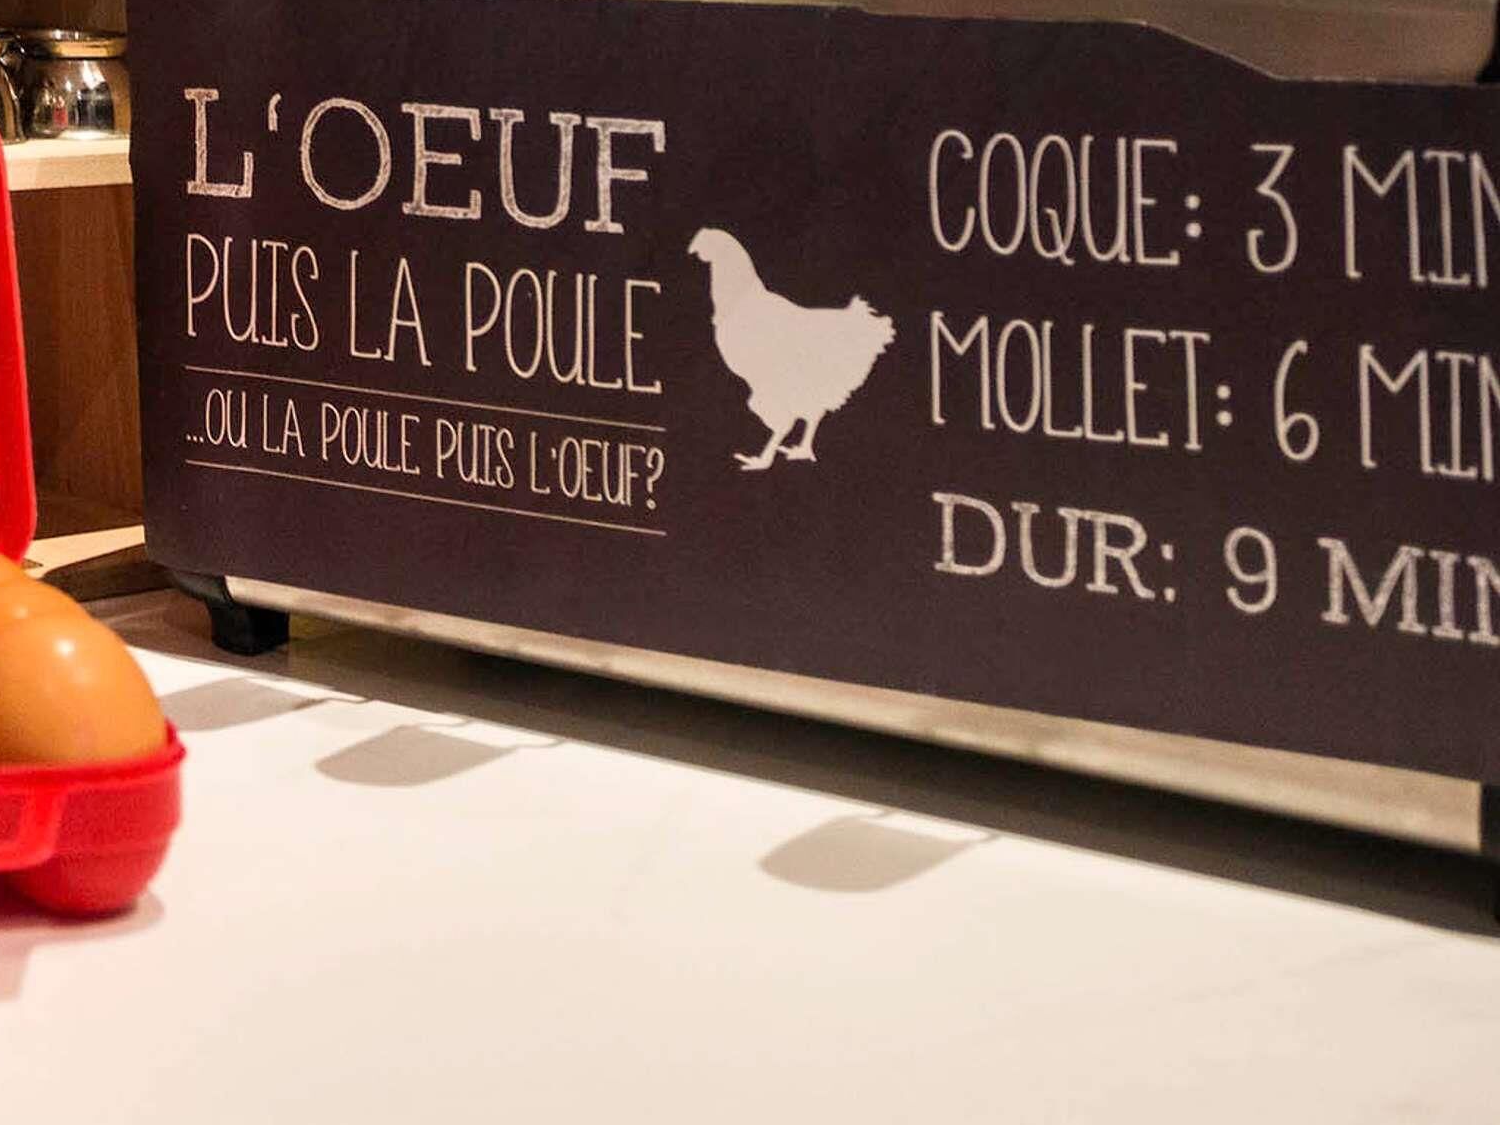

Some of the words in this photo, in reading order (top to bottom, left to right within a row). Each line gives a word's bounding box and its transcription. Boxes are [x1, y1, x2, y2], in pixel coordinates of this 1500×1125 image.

[184, 88, 665, 235] L'OEUF
[929, 129, 1201, 266] COQUE:
[1247, 143, 1297, 273] 3
[187, 234, 318, 350] PUIS
[350, 250, 431, 366] LA
[463, 262, 662, 393] POULE
[931, 311, 1232, 451] MOLLET:
[1275, 340, 1319, 461] 6
[187, 389, 247, 448] ...OU
[263, 394, 305, 457] LA
[322, 403, 420, 475] POULE
[437, 415, 515, 490] PUIS
[530, 437, 666, 511] L'OEUF?
[932, 492, 1175, 602] DUR:
[1224, 527, 1277, 614] 9
